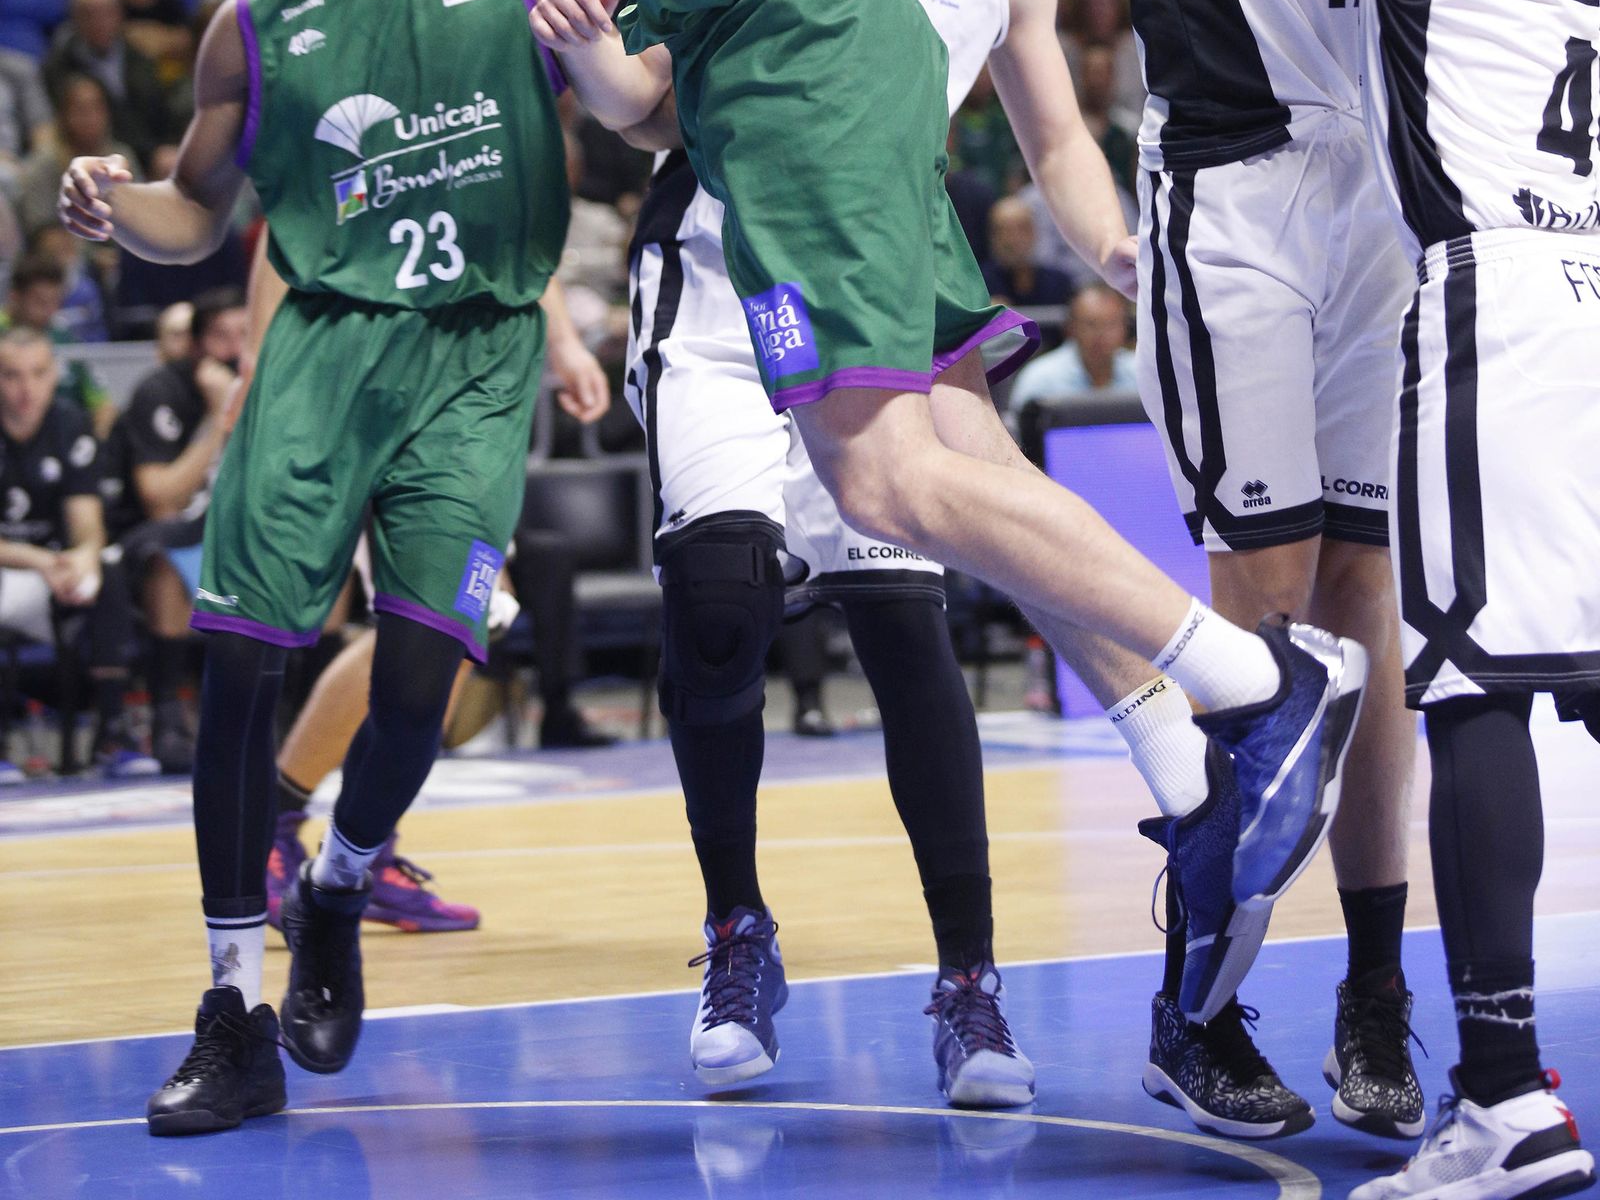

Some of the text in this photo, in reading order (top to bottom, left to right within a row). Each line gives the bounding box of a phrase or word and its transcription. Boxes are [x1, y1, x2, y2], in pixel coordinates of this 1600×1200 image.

[394, 91, 500, 141] Unicaja
[1536, 35, 1600, 177] 4
[389, 210, 466, 290] 23
[1333, 478, 1389, 500] CORR
[847, 547, 866, 561] EL
[1158, 610, 1206, 671] ALDING
[1110, 680, 1167, 723] ALDING
